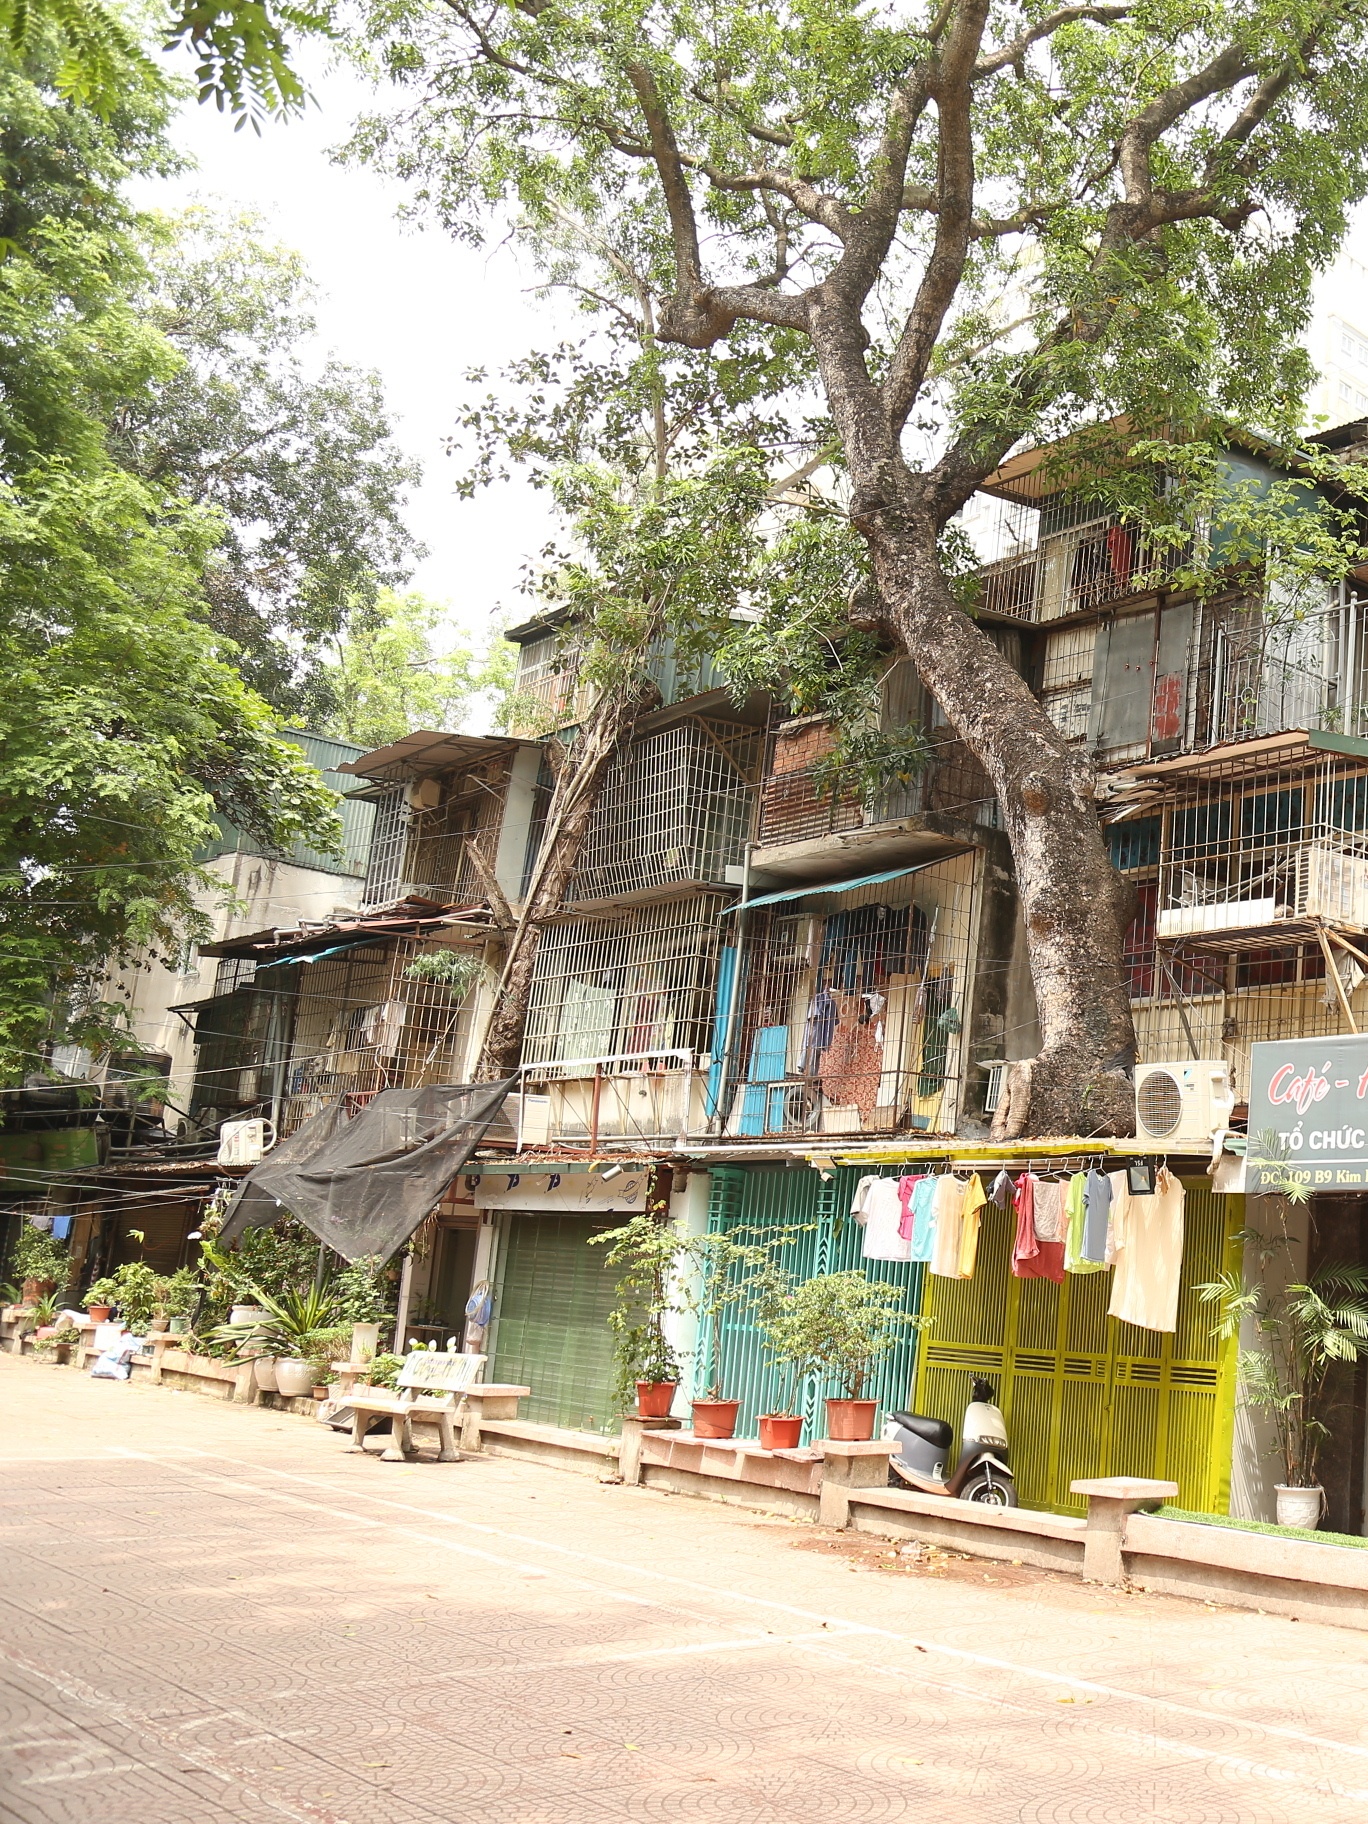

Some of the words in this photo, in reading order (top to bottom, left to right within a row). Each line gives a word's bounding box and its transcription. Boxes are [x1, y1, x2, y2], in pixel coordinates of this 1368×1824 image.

[1268, 1061, 1332, 1115] Café
[1278, 1121, 1304, 1150] TỔ
[1309, 1125, 1366, 1149] CHỨC
[1288, 1170, 1311, 1184] 109
[1314, 1170, 1333, 1184] B9
[1336, 1170, 1361, 1183] Kim
